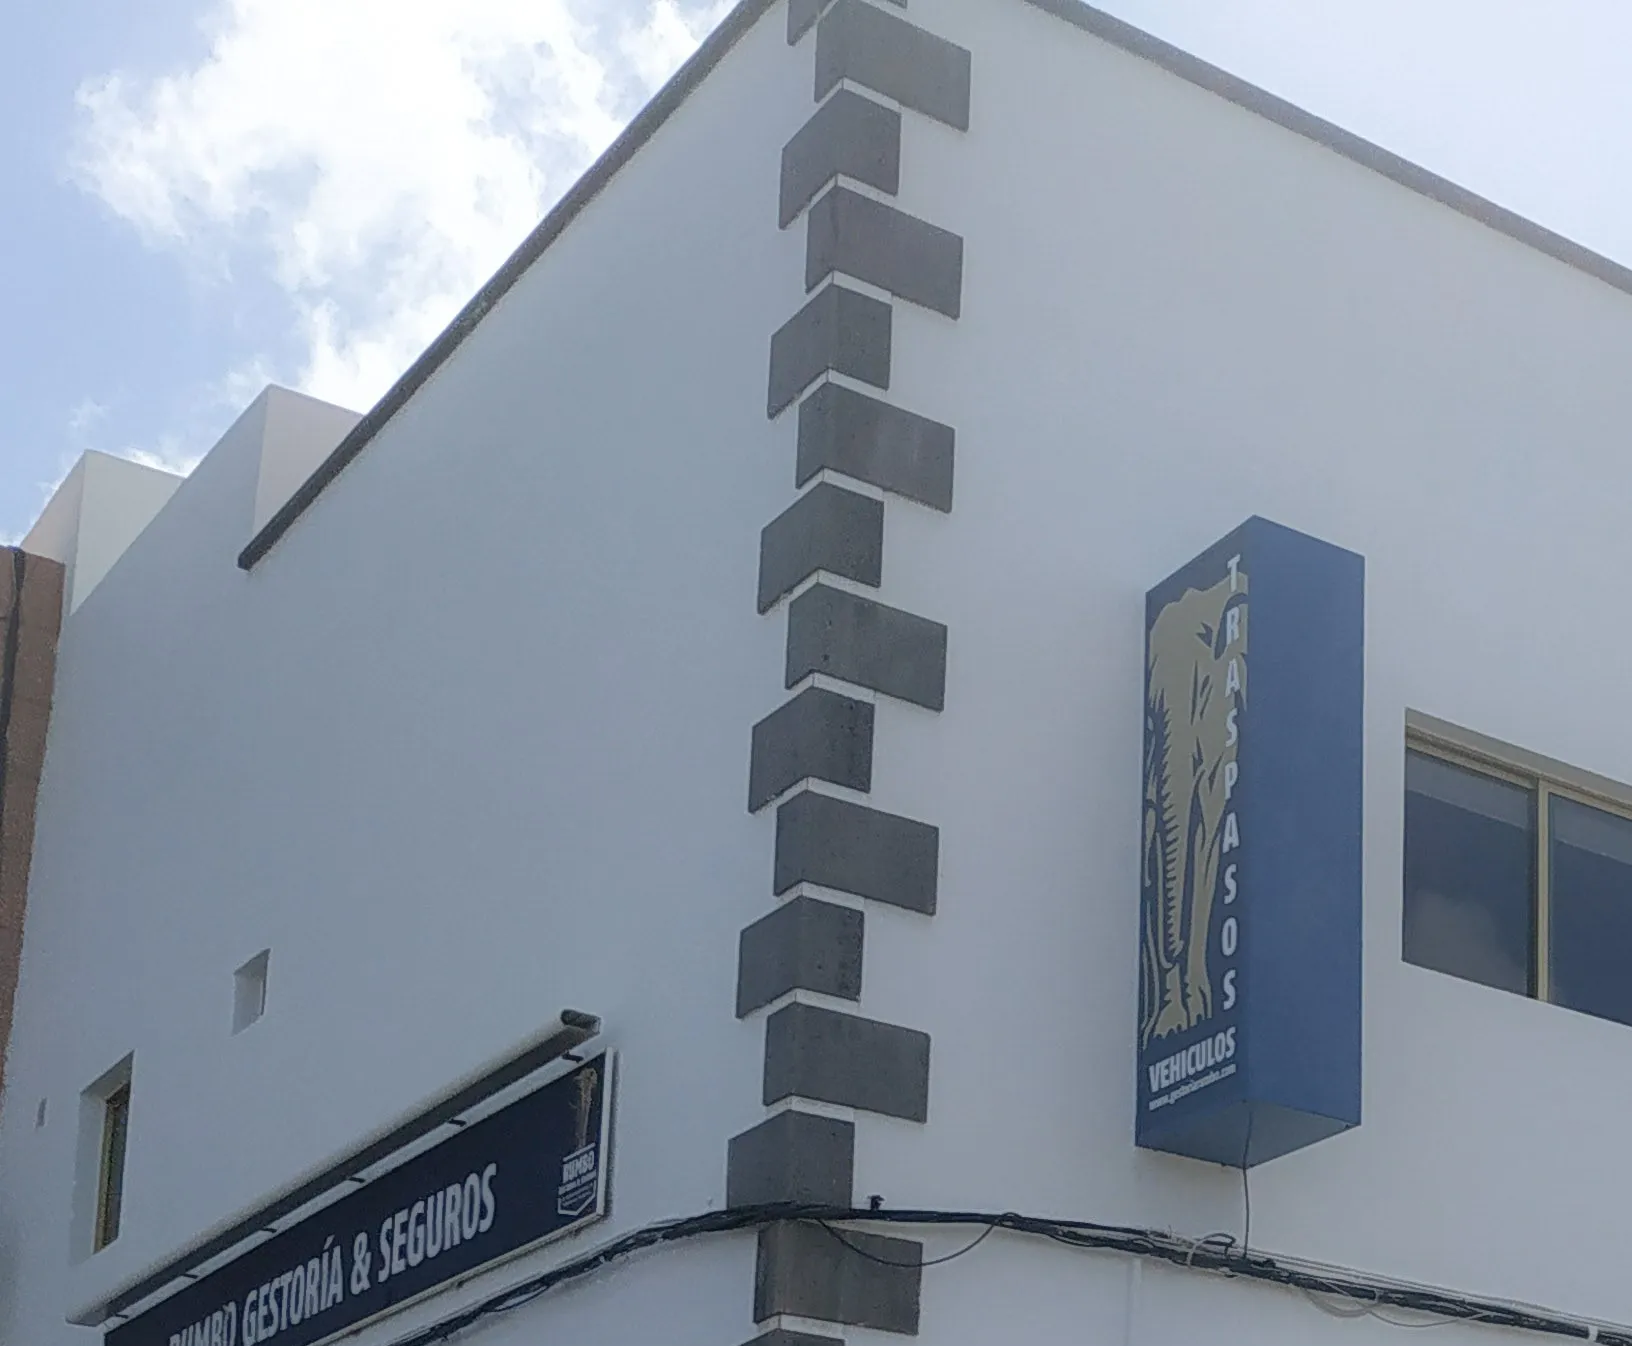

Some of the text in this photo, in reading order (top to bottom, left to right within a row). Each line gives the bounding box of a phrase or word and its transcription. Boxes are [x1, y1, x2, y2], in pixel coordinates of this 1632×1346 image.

[1221, 554, 1241, 1011] TRASPASOS
[1149, 1026, 1237, 1093] VEHICULOS
[350, 1232, 372, 1295] &
[378, 1164, 496, 1284] SEGUROS
